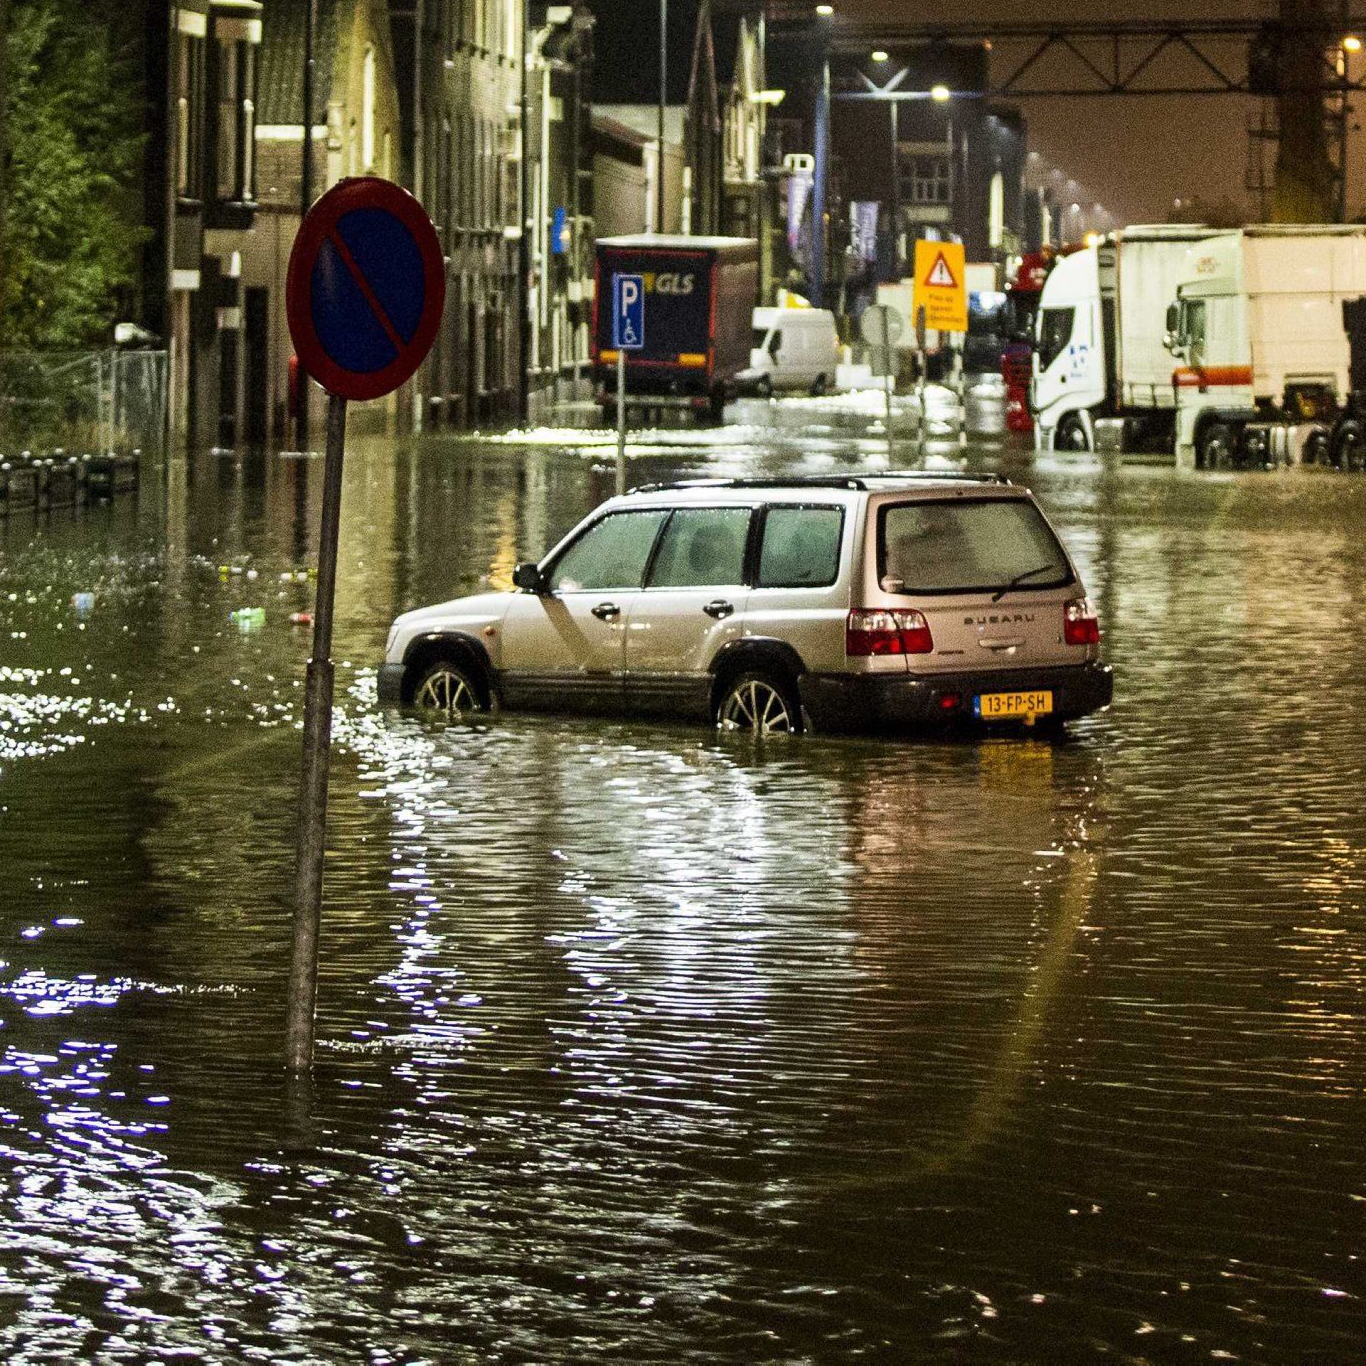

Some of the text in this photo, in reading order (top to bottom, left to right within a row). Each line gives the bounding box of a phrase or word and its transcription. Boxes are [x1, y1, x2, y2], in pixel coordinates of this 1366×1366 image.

[656, 273, 695, 294] GLS
[621, 280, 639, 317] P
[963, 613, 1035, 625] SUBARU
[988, 695, 1046, 712] 13-FP-SH
